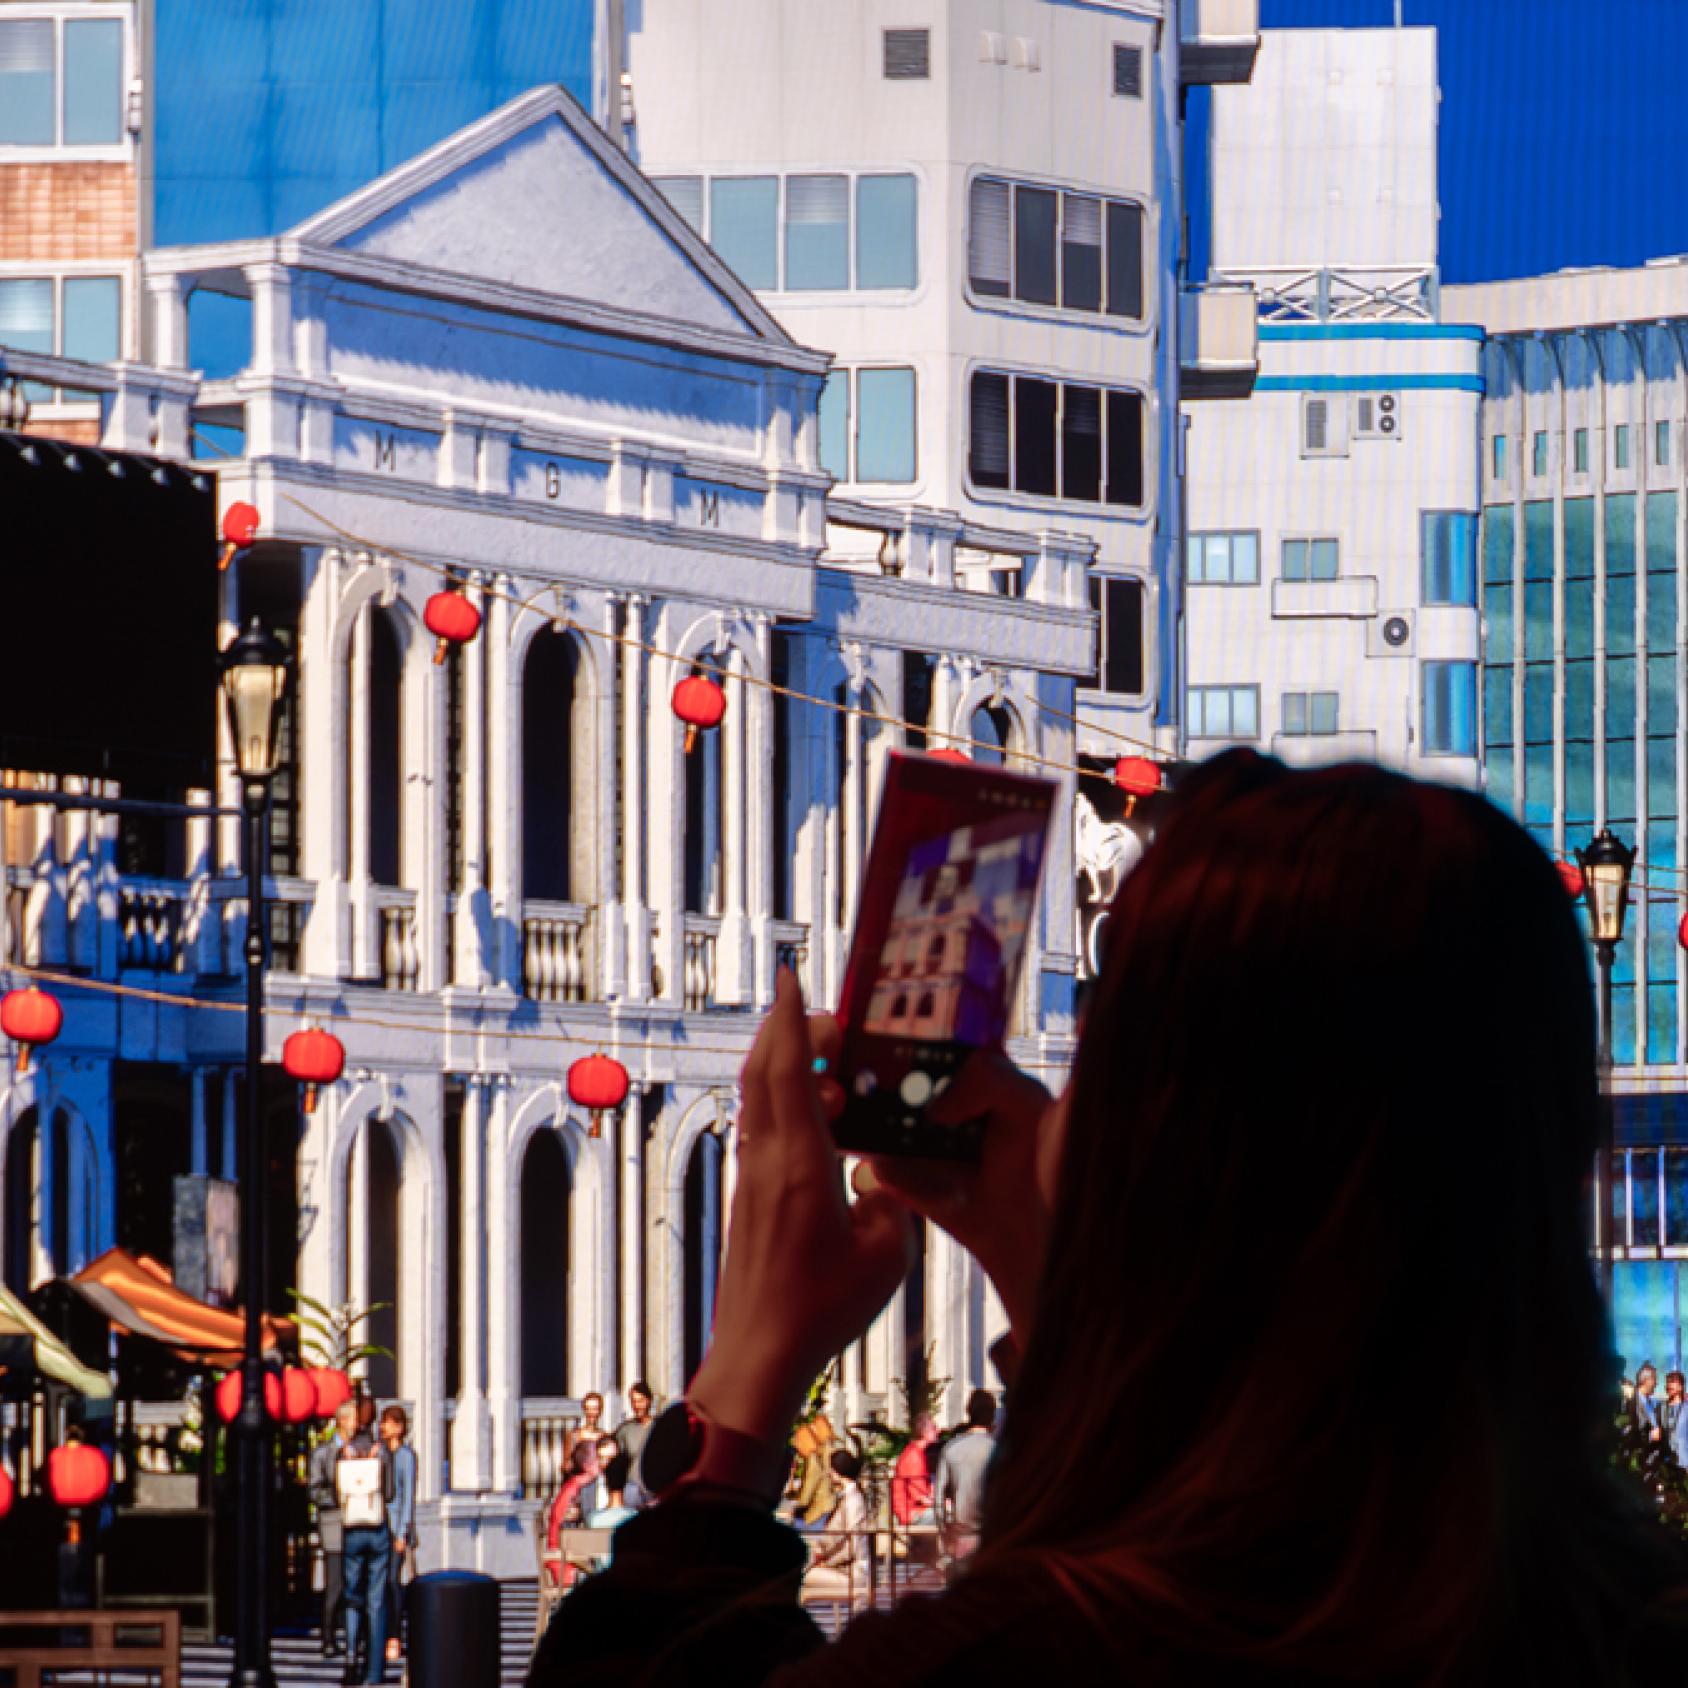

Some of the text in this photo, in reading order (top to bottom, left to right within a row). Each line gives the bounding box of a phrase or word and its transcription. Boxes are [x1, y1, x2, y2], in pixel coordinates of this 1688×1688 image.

[375, 429, 719, 527] M G M
